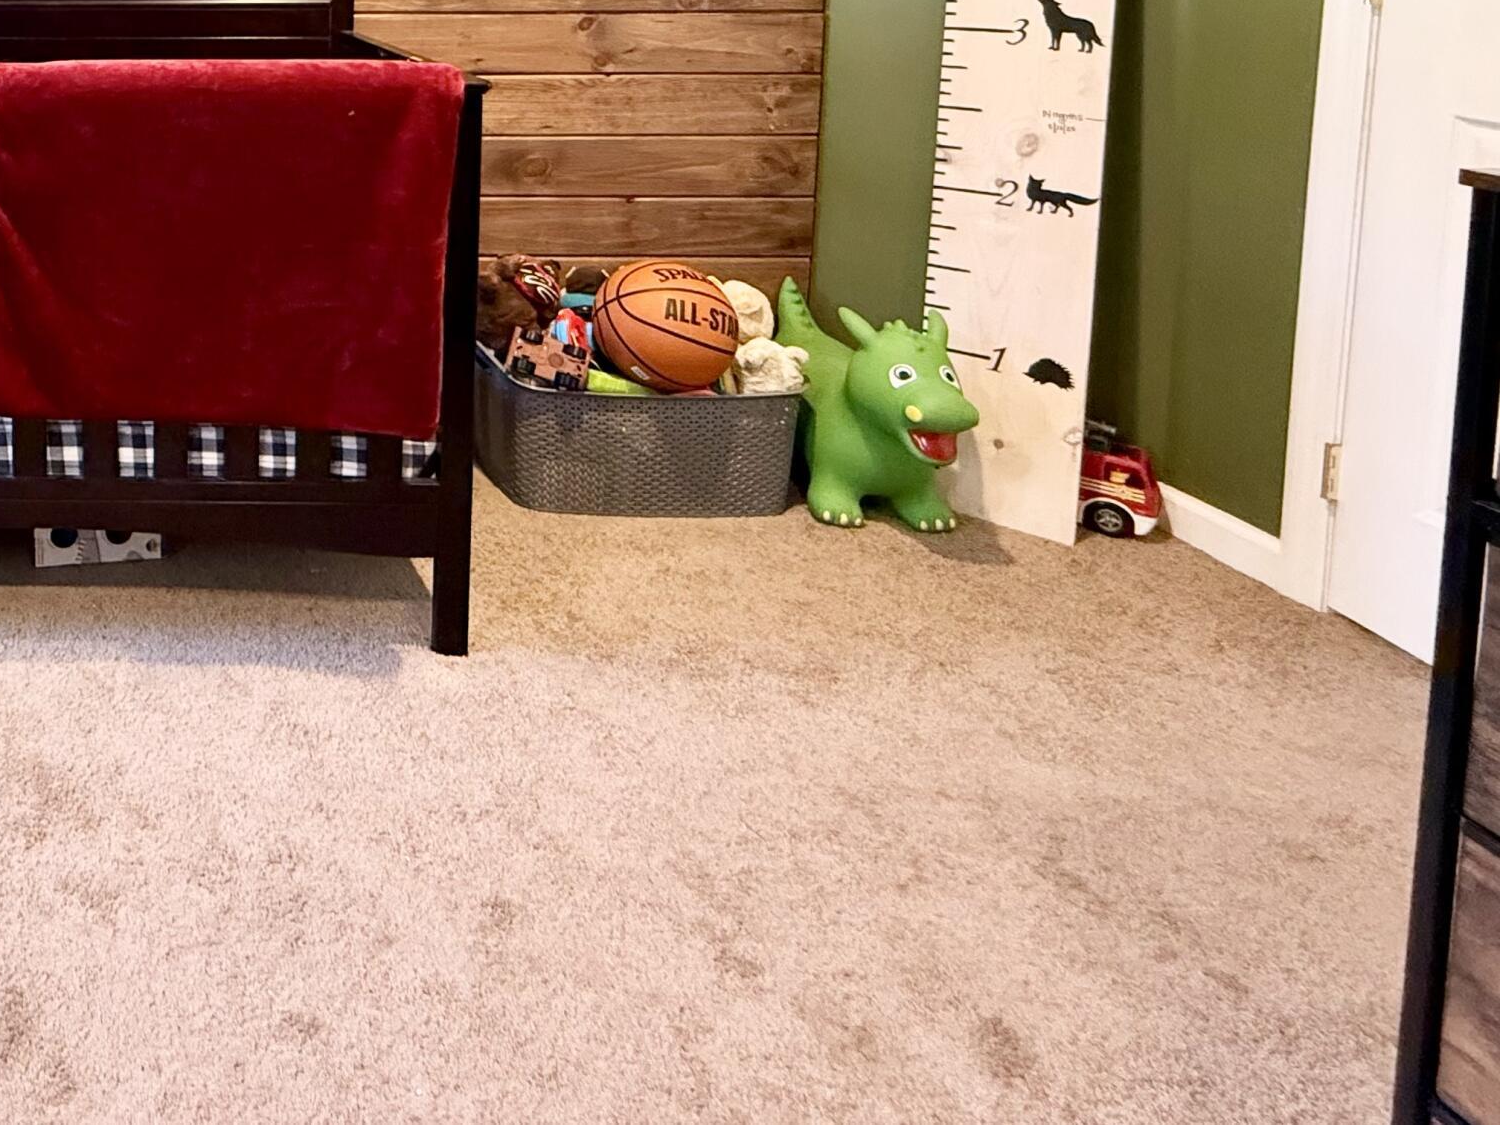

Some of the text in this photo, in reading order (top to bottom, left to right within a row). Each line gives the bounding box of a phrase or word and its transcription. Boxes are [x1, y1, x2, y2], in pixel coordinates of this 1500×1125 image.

[1005, 18, 1029, 45] 3
[994, 179, 1019, 207] 2
[652, 267, 714, 286] SPAL
[985, 346, 1007, 374] 1
